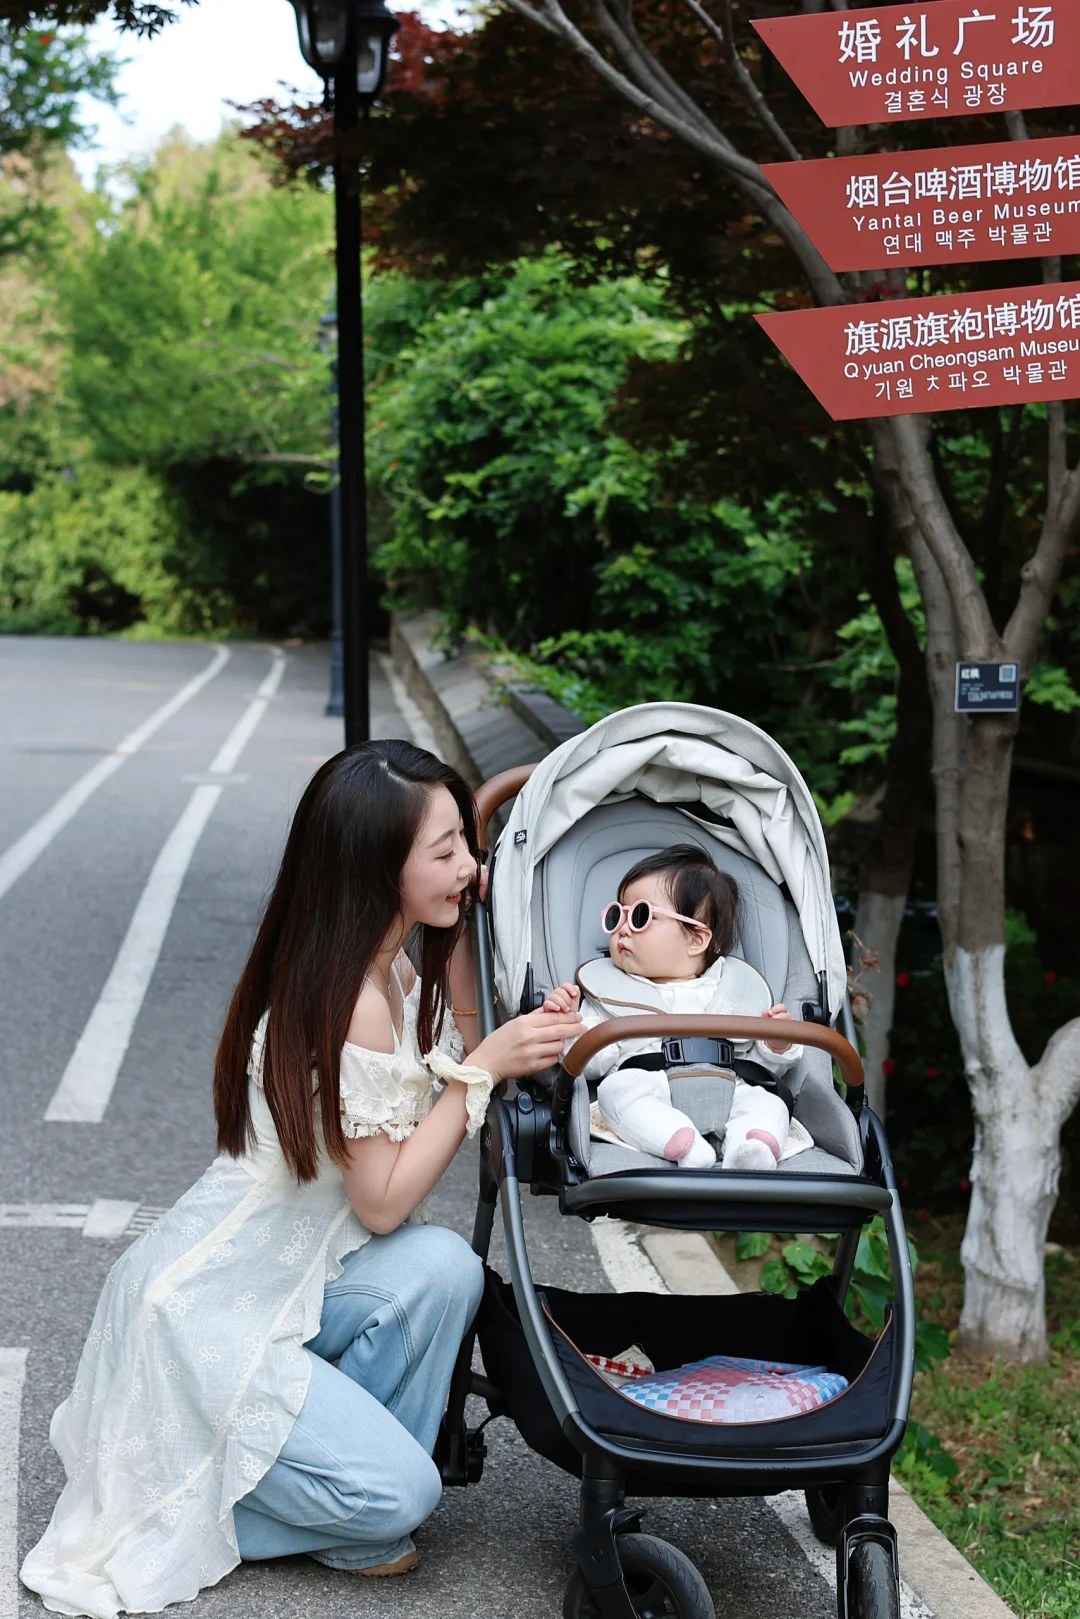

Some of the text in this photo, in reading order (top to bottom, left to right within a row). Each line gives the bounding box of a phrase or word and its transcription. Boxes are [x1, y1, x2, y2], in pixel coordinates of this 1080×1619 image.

[837, 6, 1055, 64] 婚礼广场
[849, 59, 1043, 88] Wedding Square
[884, 82, 1007, 114] 결혼식 광장
[845, 154, 1080, 209] 烟台啤酒博物馆
[932, 208, 983, 226] Beer
[993, 199, 1080, 221] Museum
[883, 221, 1052, 255] 연대 맥주 박물관
[843, 293, 1080, 356] 旗源旗袍博物馆
[909, 346, 1015, 371] Cheongsam
[874, 377, 914, 401] 기원
[1002, 359, 1068, 386] 박물관
